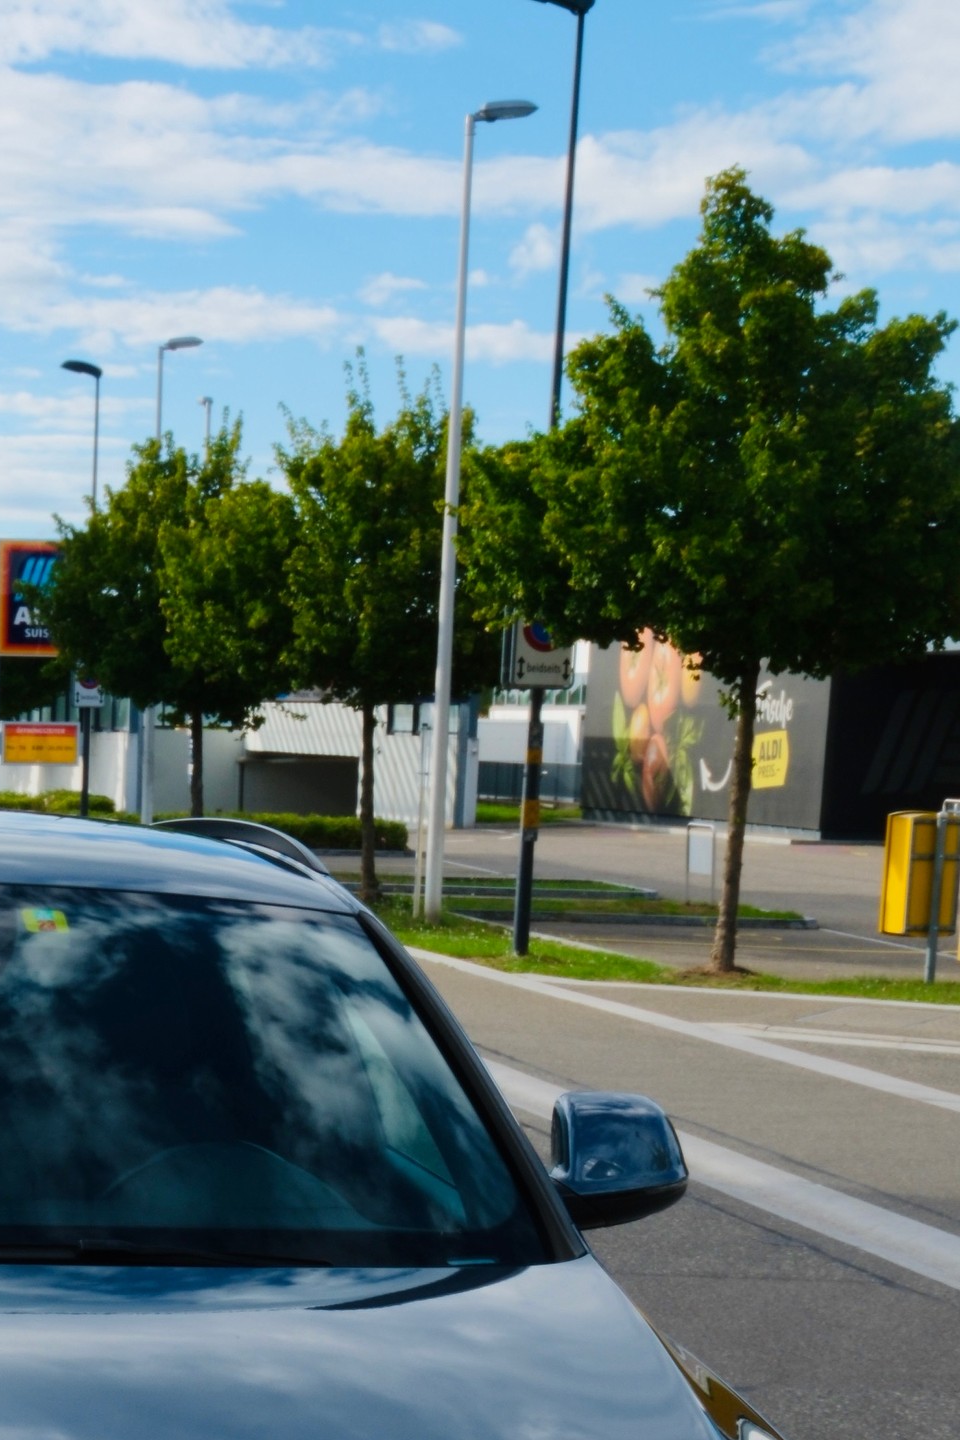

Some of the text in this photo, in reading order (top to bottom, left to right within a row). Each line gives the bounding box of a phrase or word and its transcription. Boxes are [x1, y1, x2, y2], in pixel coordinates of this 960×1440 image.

[24, 628, 50, 639] SUIS
[526, 662, 561, 673] beidseits
[758, 738, 783, 763] ALDI
